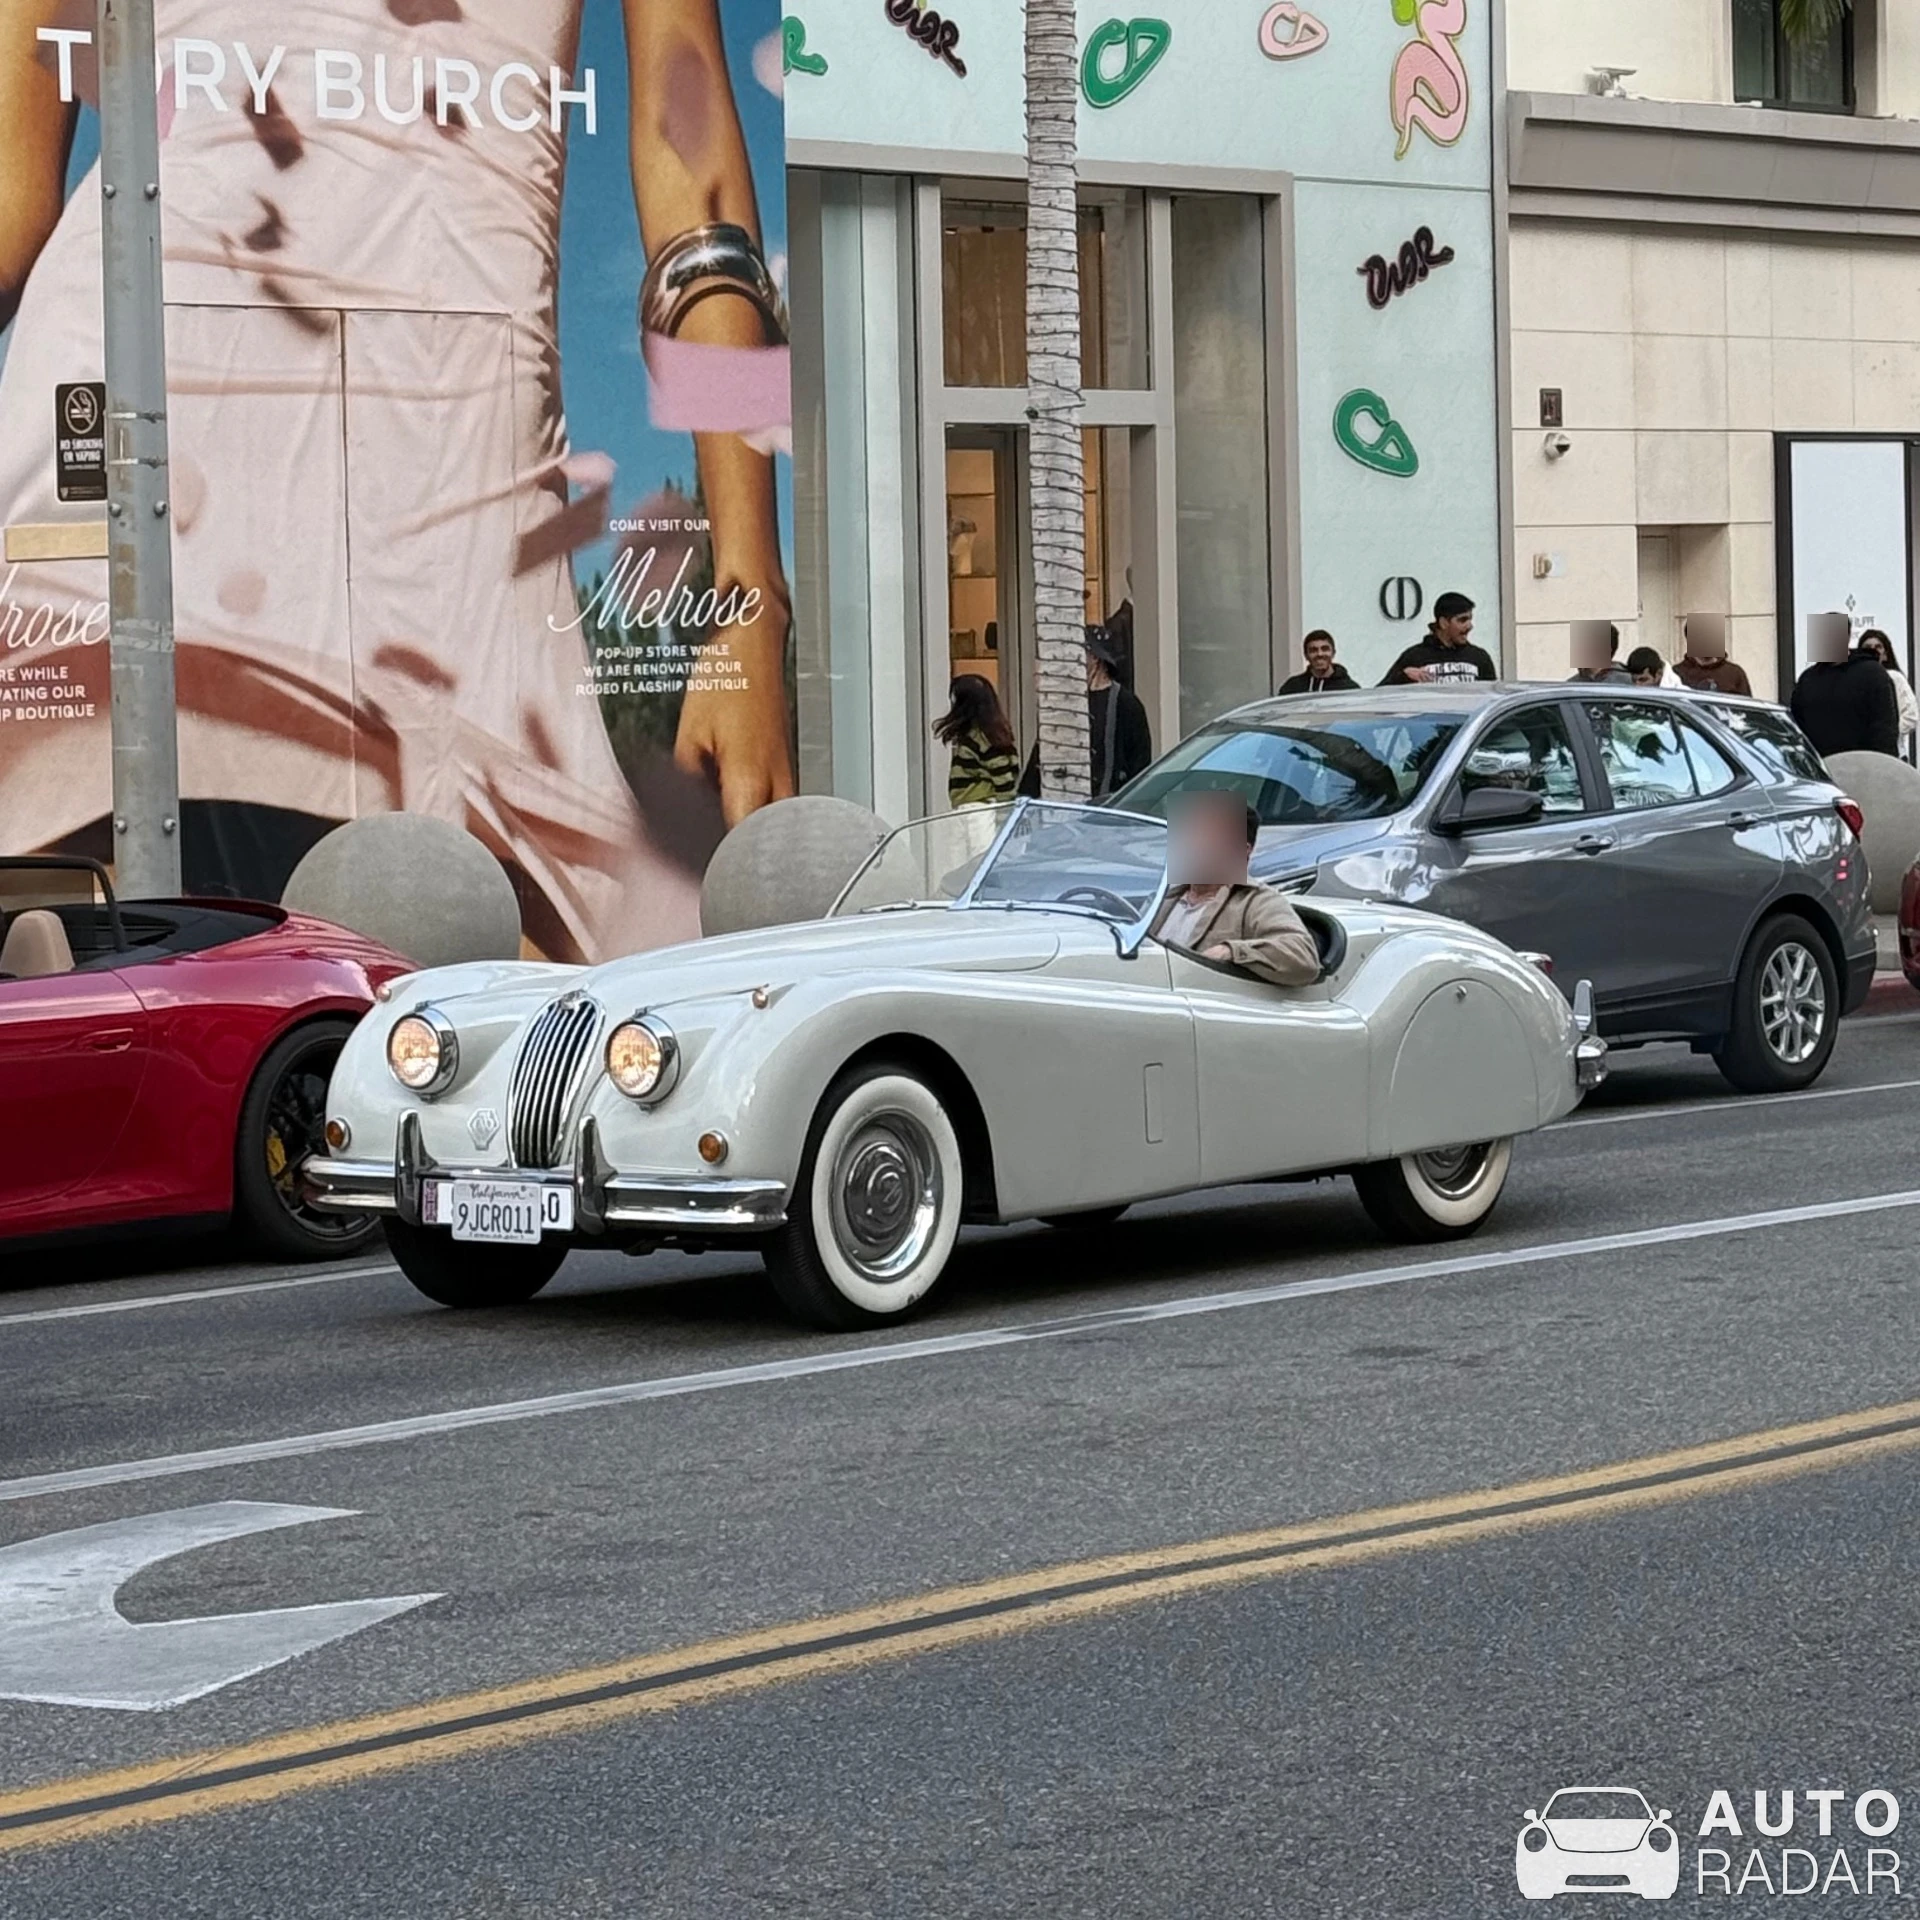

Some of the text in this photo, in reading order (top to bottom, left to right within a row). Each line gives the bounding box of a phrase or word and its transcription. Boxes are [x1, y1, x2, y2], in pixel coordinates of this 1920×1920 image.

[35, 26, 597, 135] TRY BURCH
[609, 519, 711, 532] COME VISIT OUR
[547, 546, 765, 633] Melrose
[596, 643, 730, 660] POP-UP STORE WHILE
[19, 665, 69, 681] WHILE
[582, 660, 742, 677] WE ARE RENOVATING OUR
[0, 684, 87, 702] ATING OUR
[575, 677, 749, 697] RODEO FLAGSHIP BOUTIQUE
[15, 703, 96, 721] BOUTIQUE
[456, 1202, 536, 1235] 9JCR011
